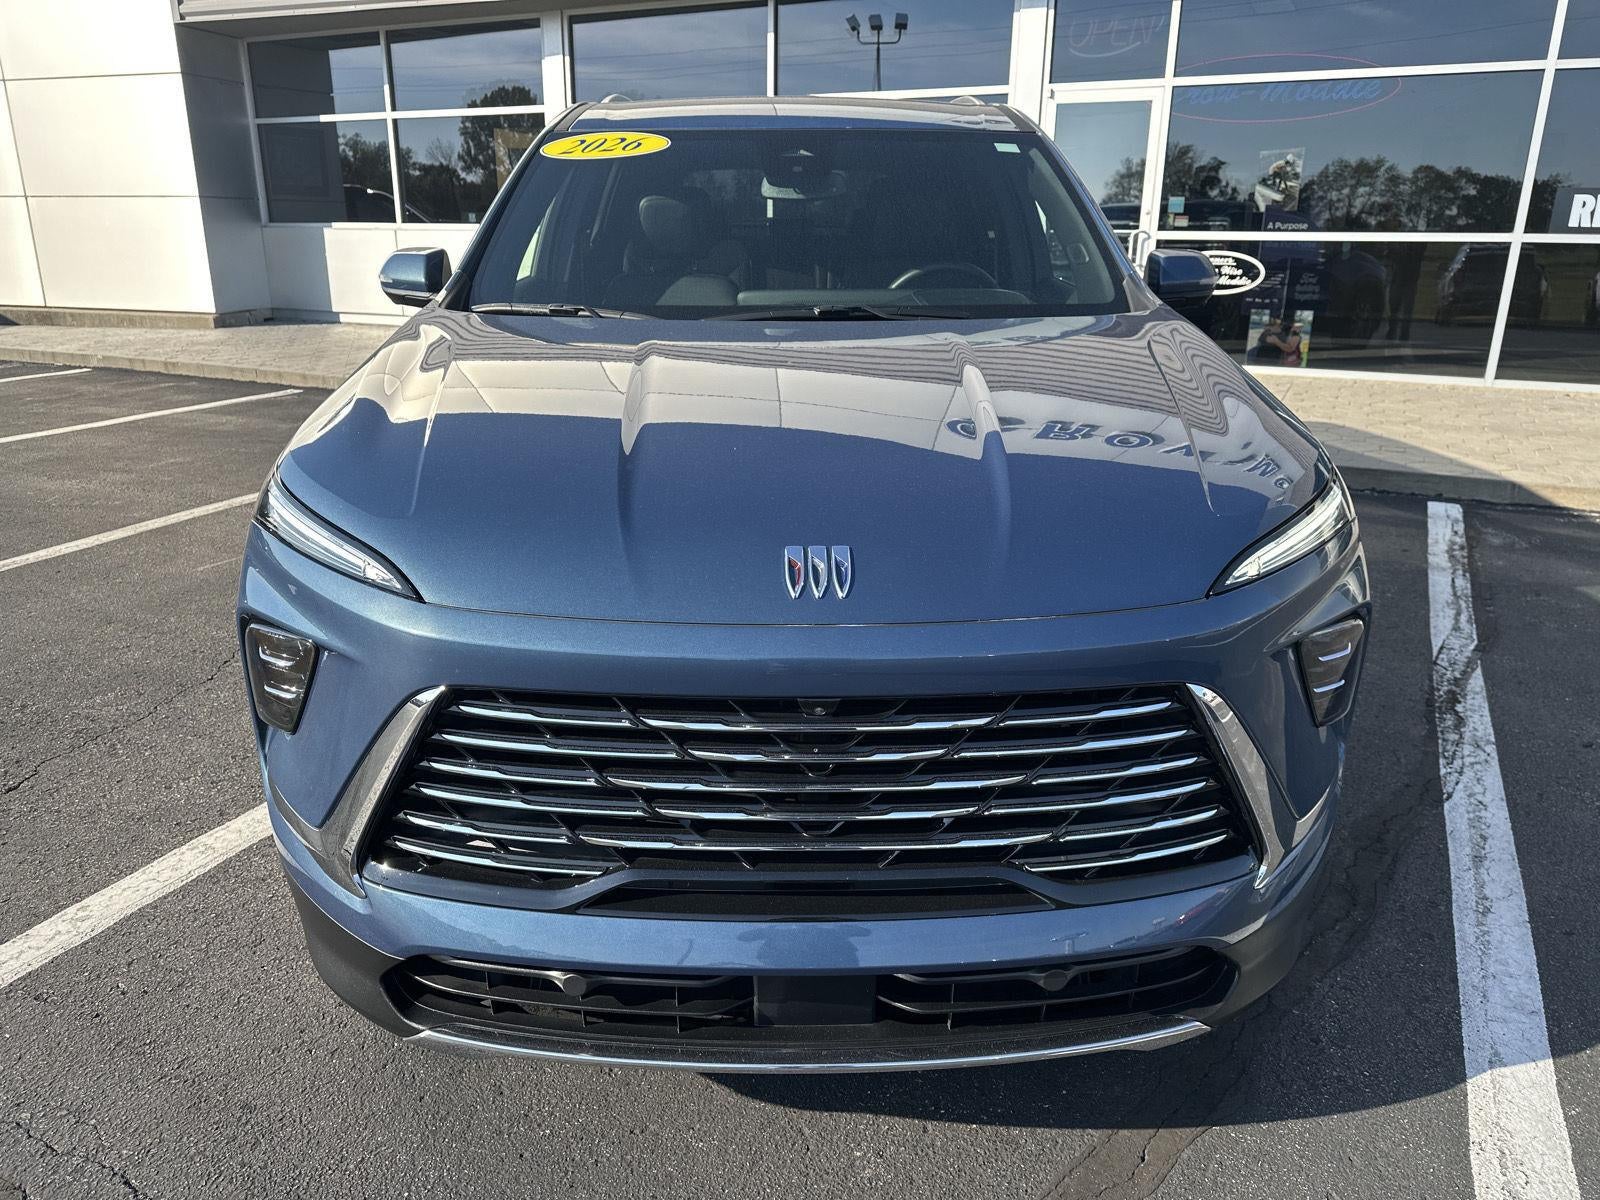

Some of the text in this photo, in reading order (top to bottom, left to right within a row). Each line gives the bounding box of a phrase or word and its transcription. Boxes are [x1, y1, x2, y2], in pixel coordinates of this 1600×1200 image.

[1069, 13, 1156, 48] OPEN
[559, 136, 647, 154] 2026
[1275, 221, 1309, 230] Purpose
